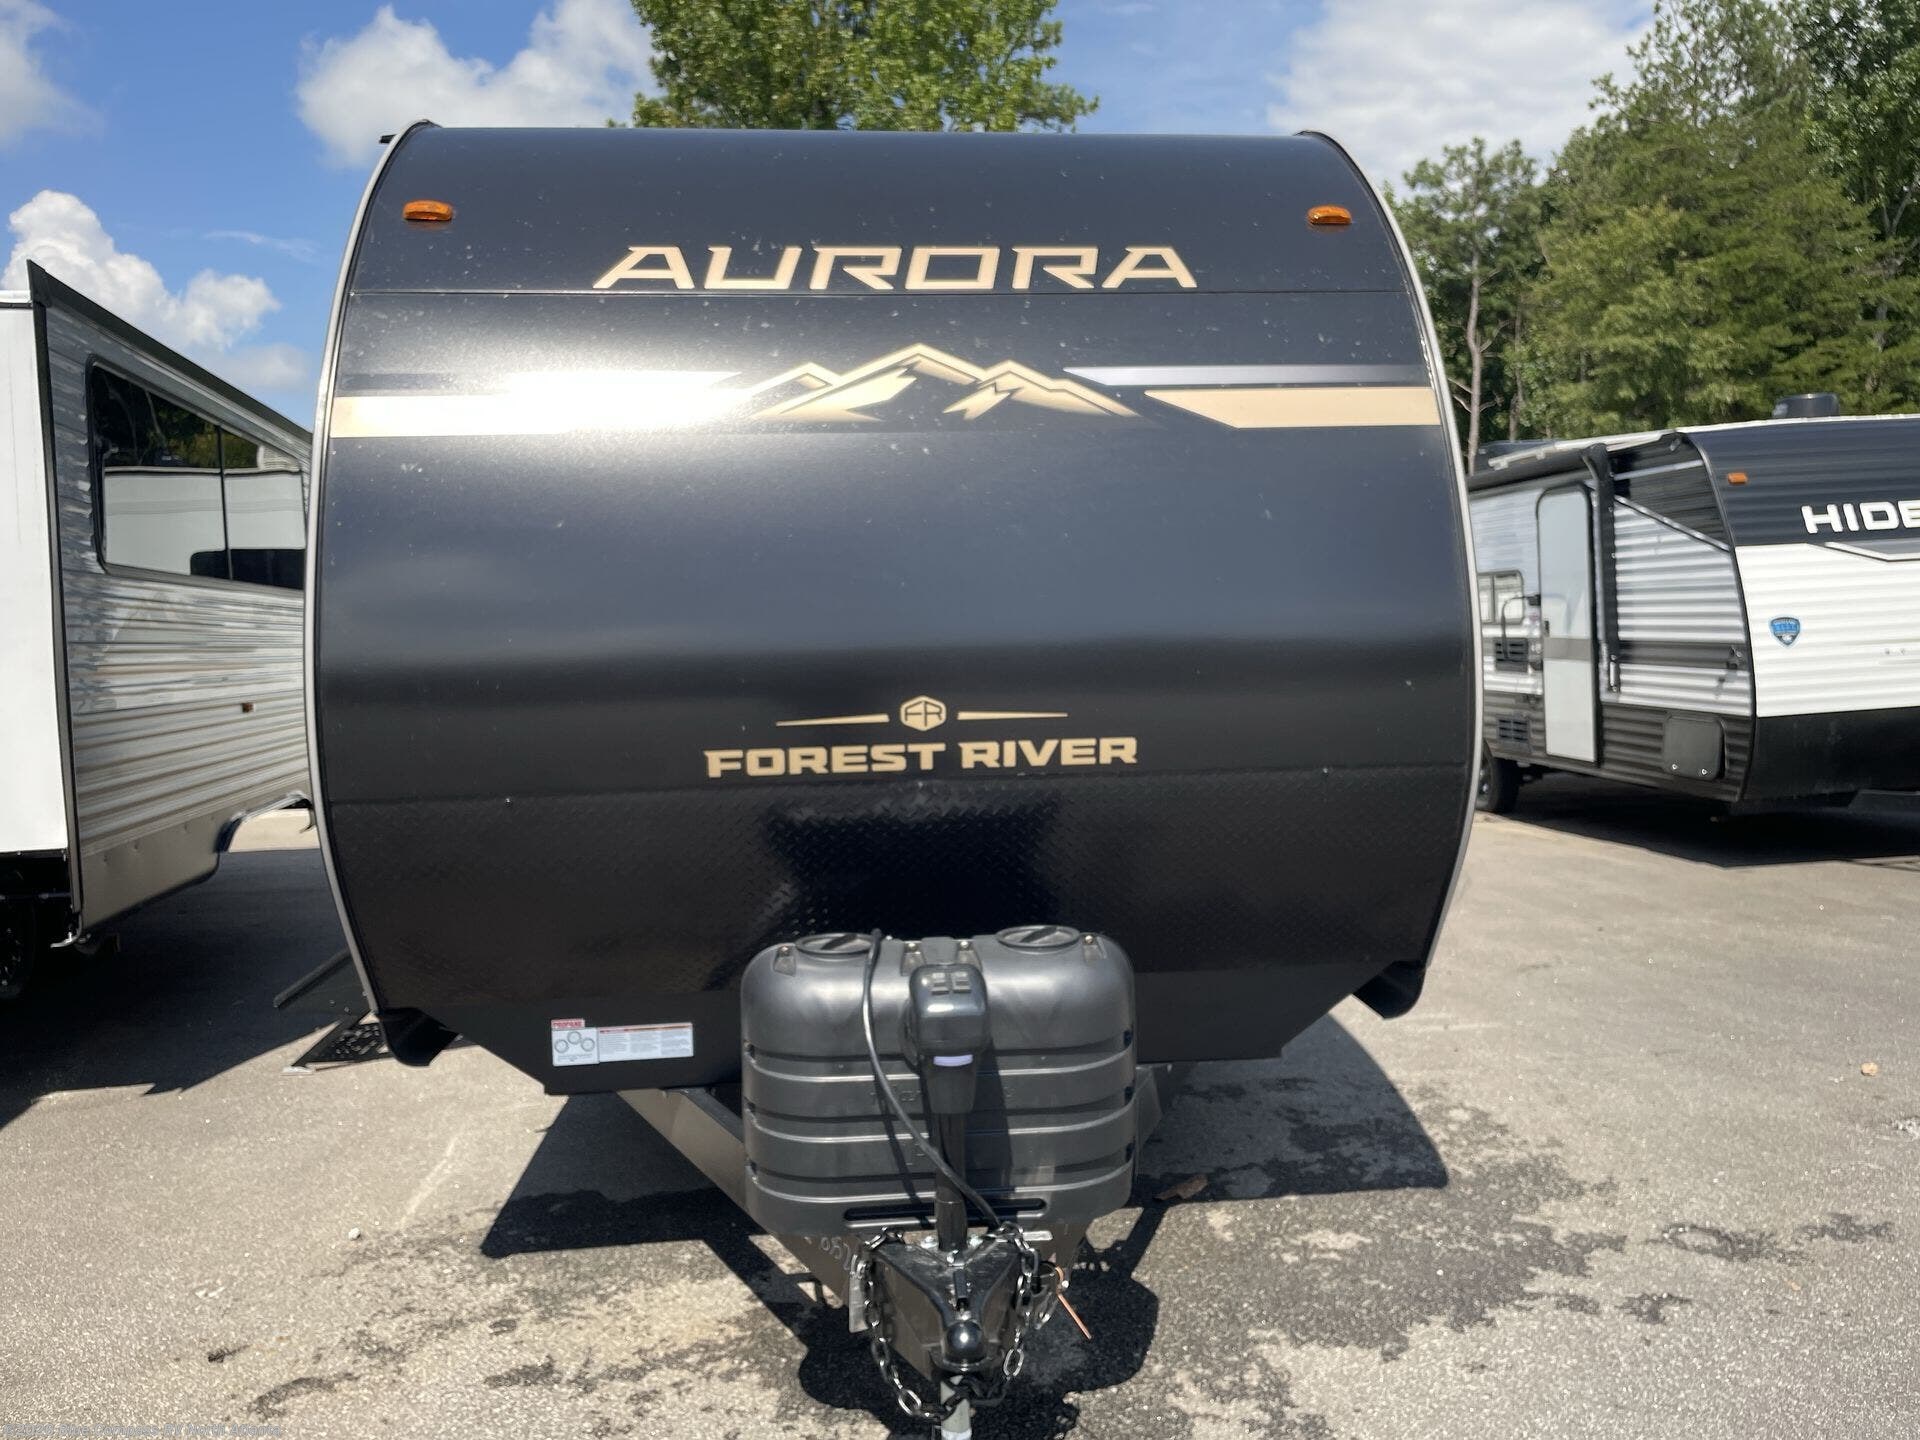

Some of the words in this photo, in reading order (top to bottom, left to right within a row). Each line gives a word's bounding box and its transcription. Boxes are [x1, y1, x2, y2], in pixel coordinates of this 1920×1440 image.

[592, 246, 1198, 290] AURORA
[1801, 500, 1920, 534] HIDE
[703, 743, 946, 778] FOREST
[958, 736, 1138, 769] RIVER
